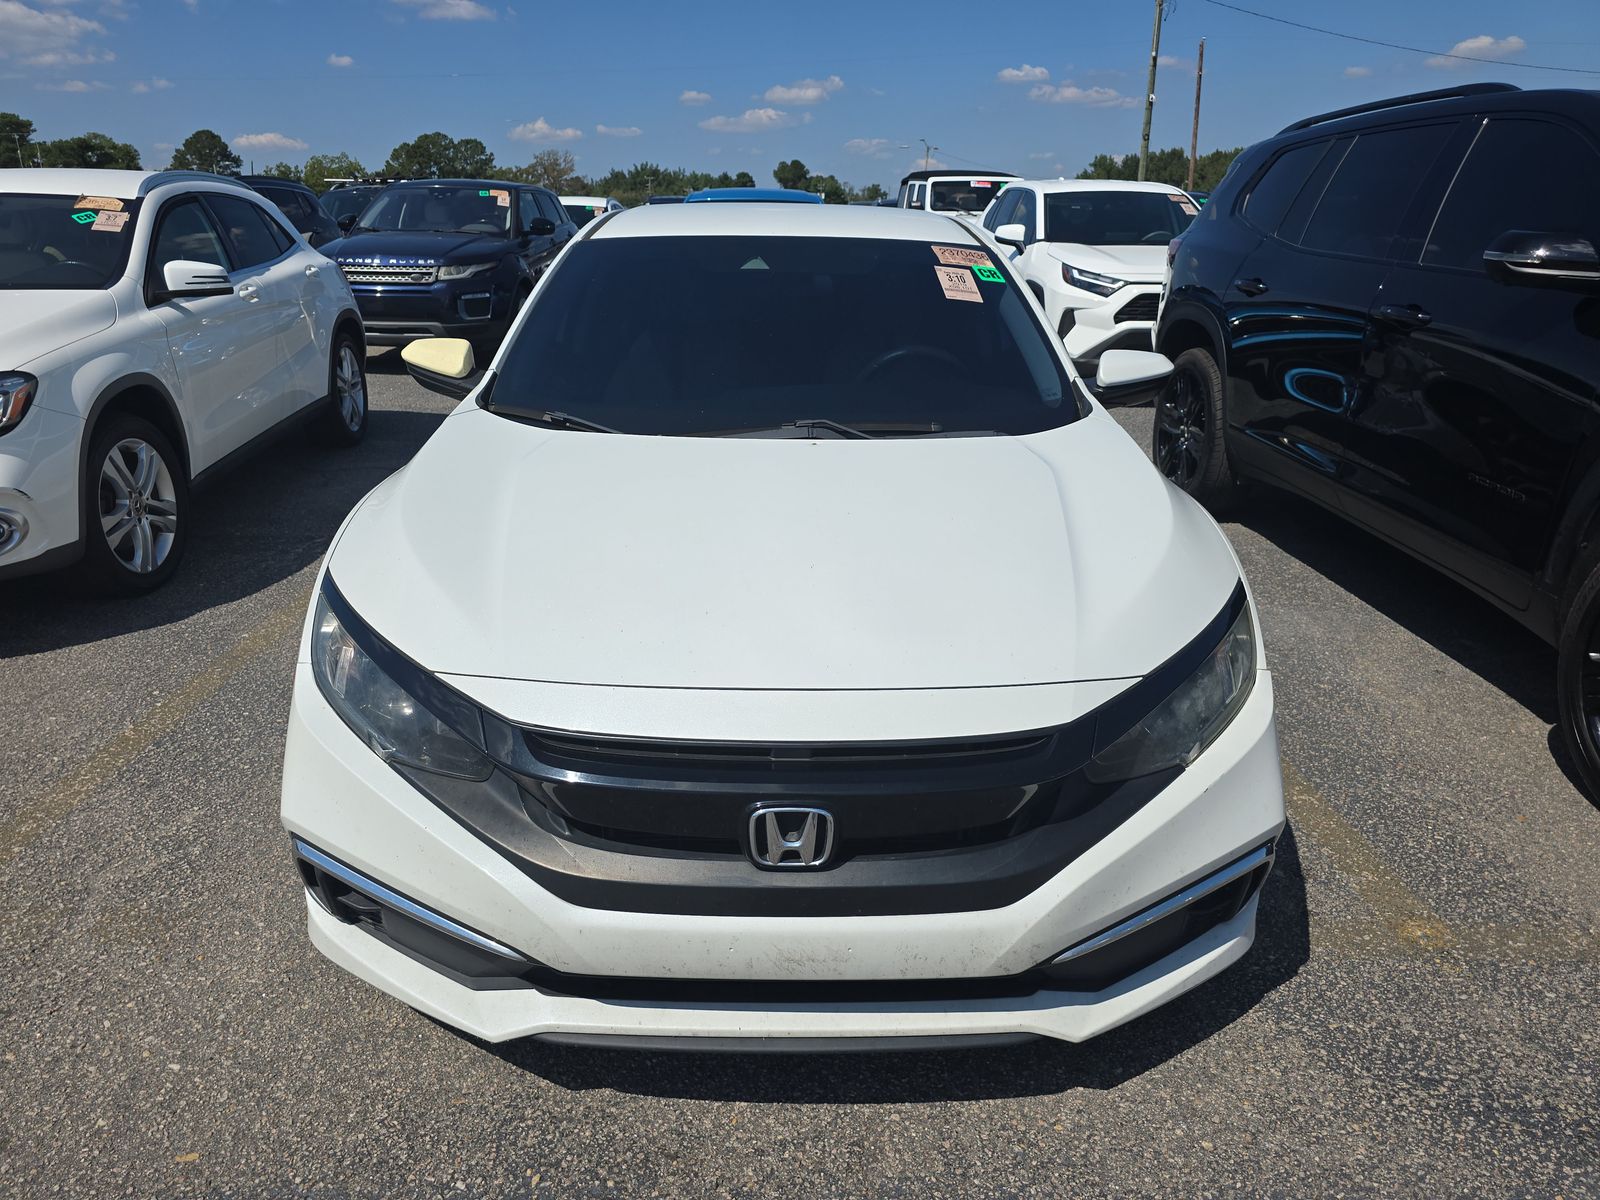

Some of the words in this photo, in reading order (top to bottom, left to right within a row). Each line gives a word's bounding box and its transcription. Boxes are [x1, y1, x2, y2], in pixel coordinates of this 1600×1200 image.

[76, 213, 96, 222] CR
[946, 273, 966, 284] 3:10
[977, 268, 1001, 280] CR
